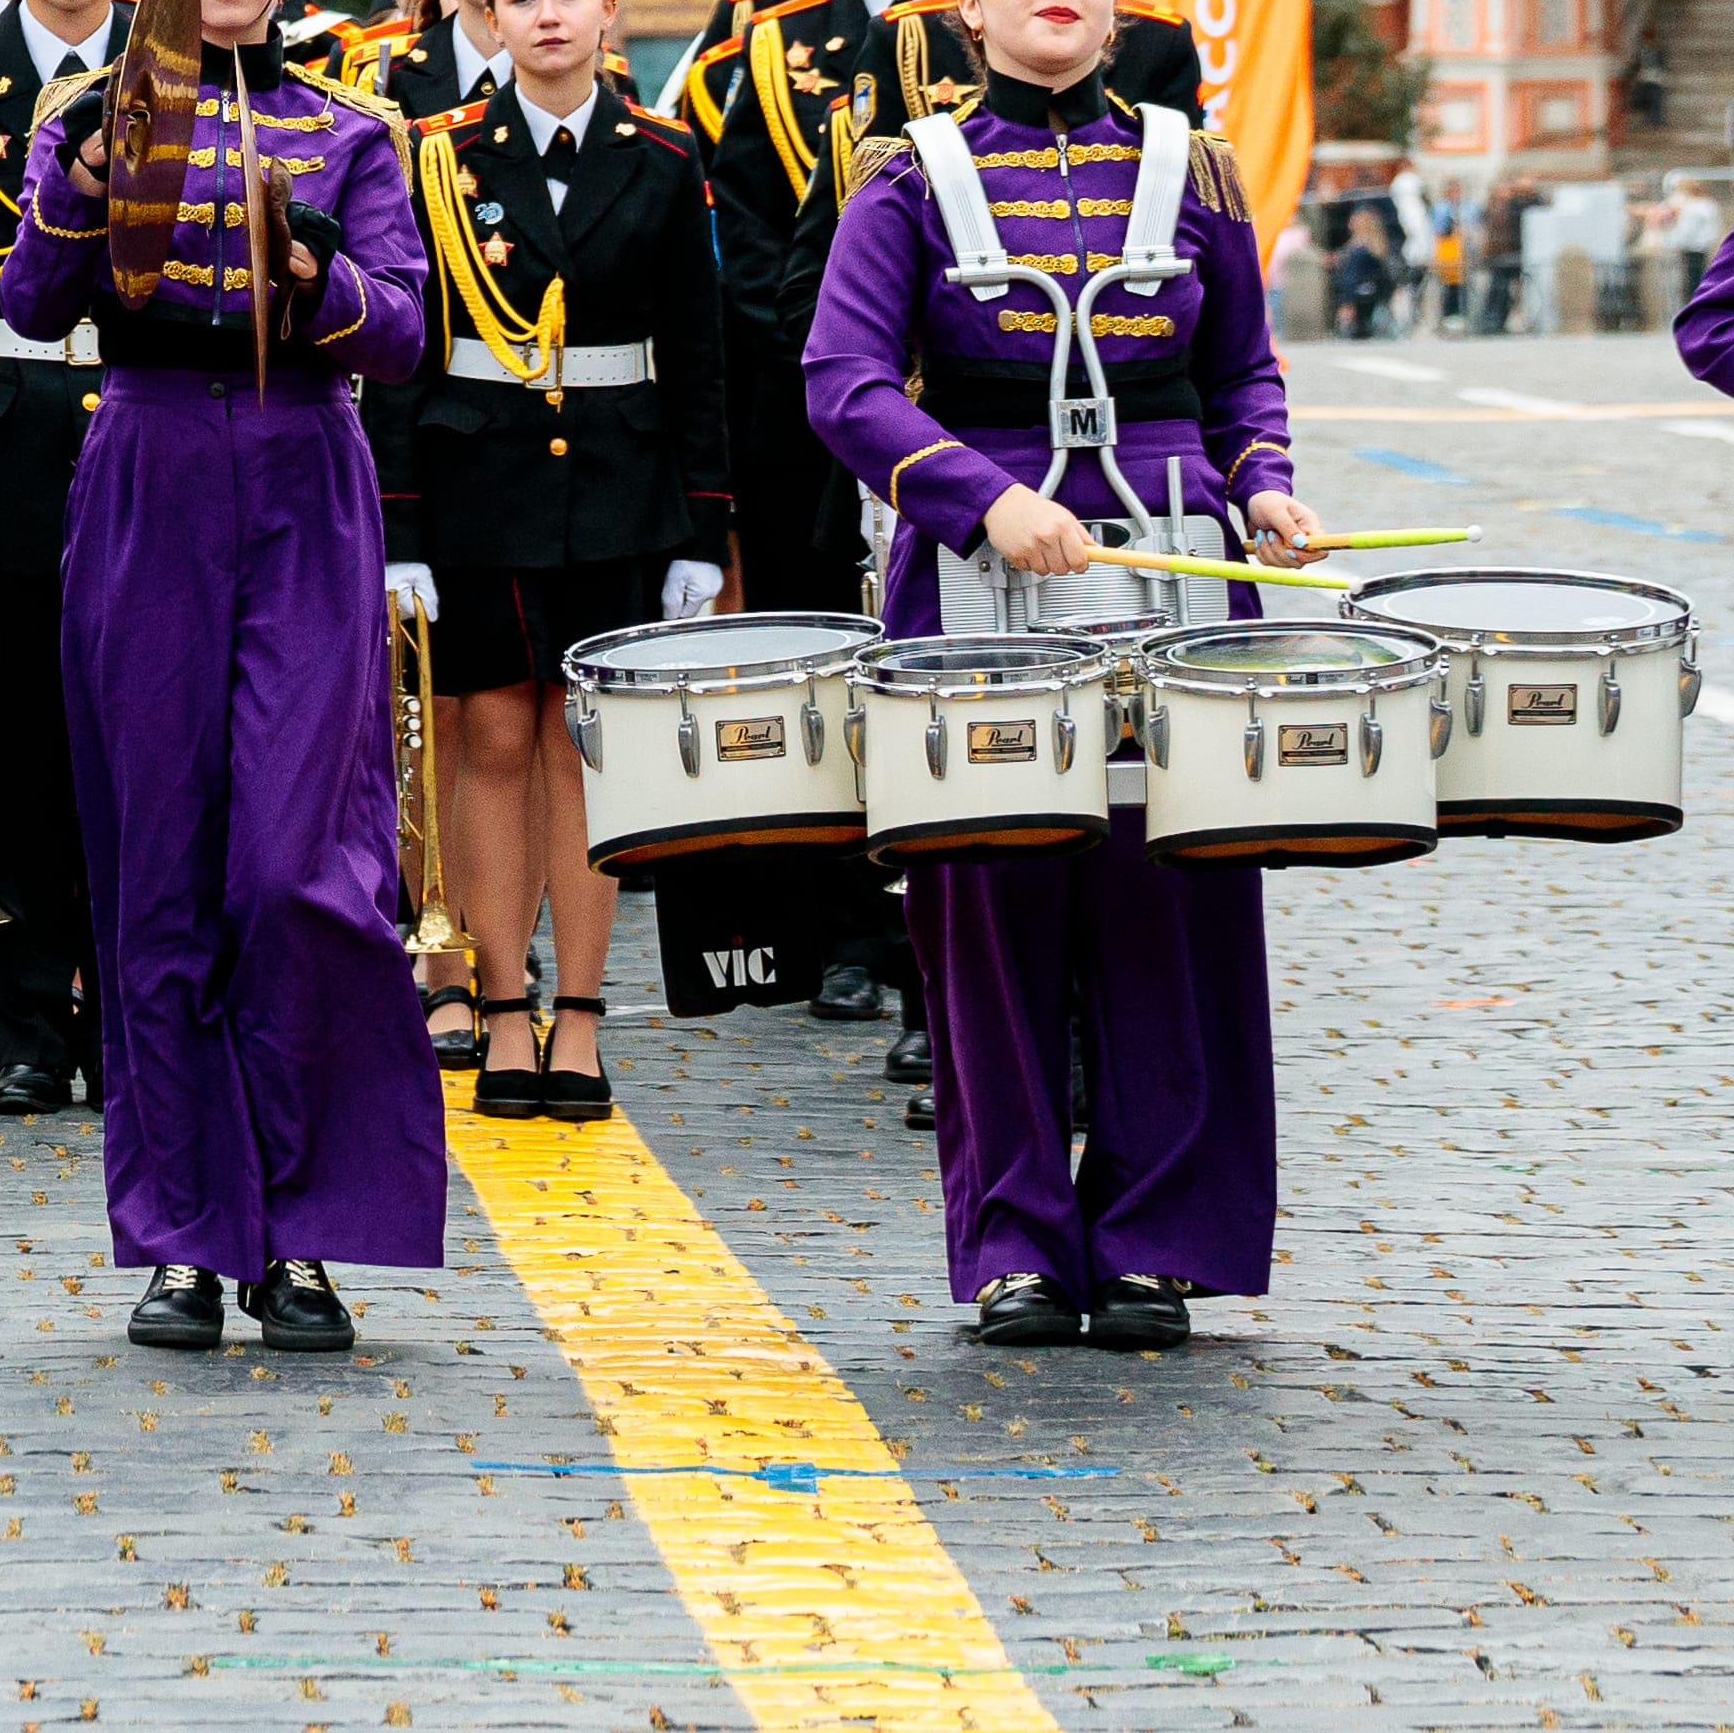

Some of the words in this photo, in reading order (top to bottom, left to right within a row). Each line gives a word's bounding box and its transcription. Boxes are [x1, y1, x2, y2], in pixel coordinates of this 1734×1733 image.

[1070, 408, 1097, 435] M
[1522, 690, 1566, 709] Pearl
[731, 725, 771, 744] Pearl
[982, 728, 1023, 747] Pearl
[1293, 731, 1335, 749] Pearl
